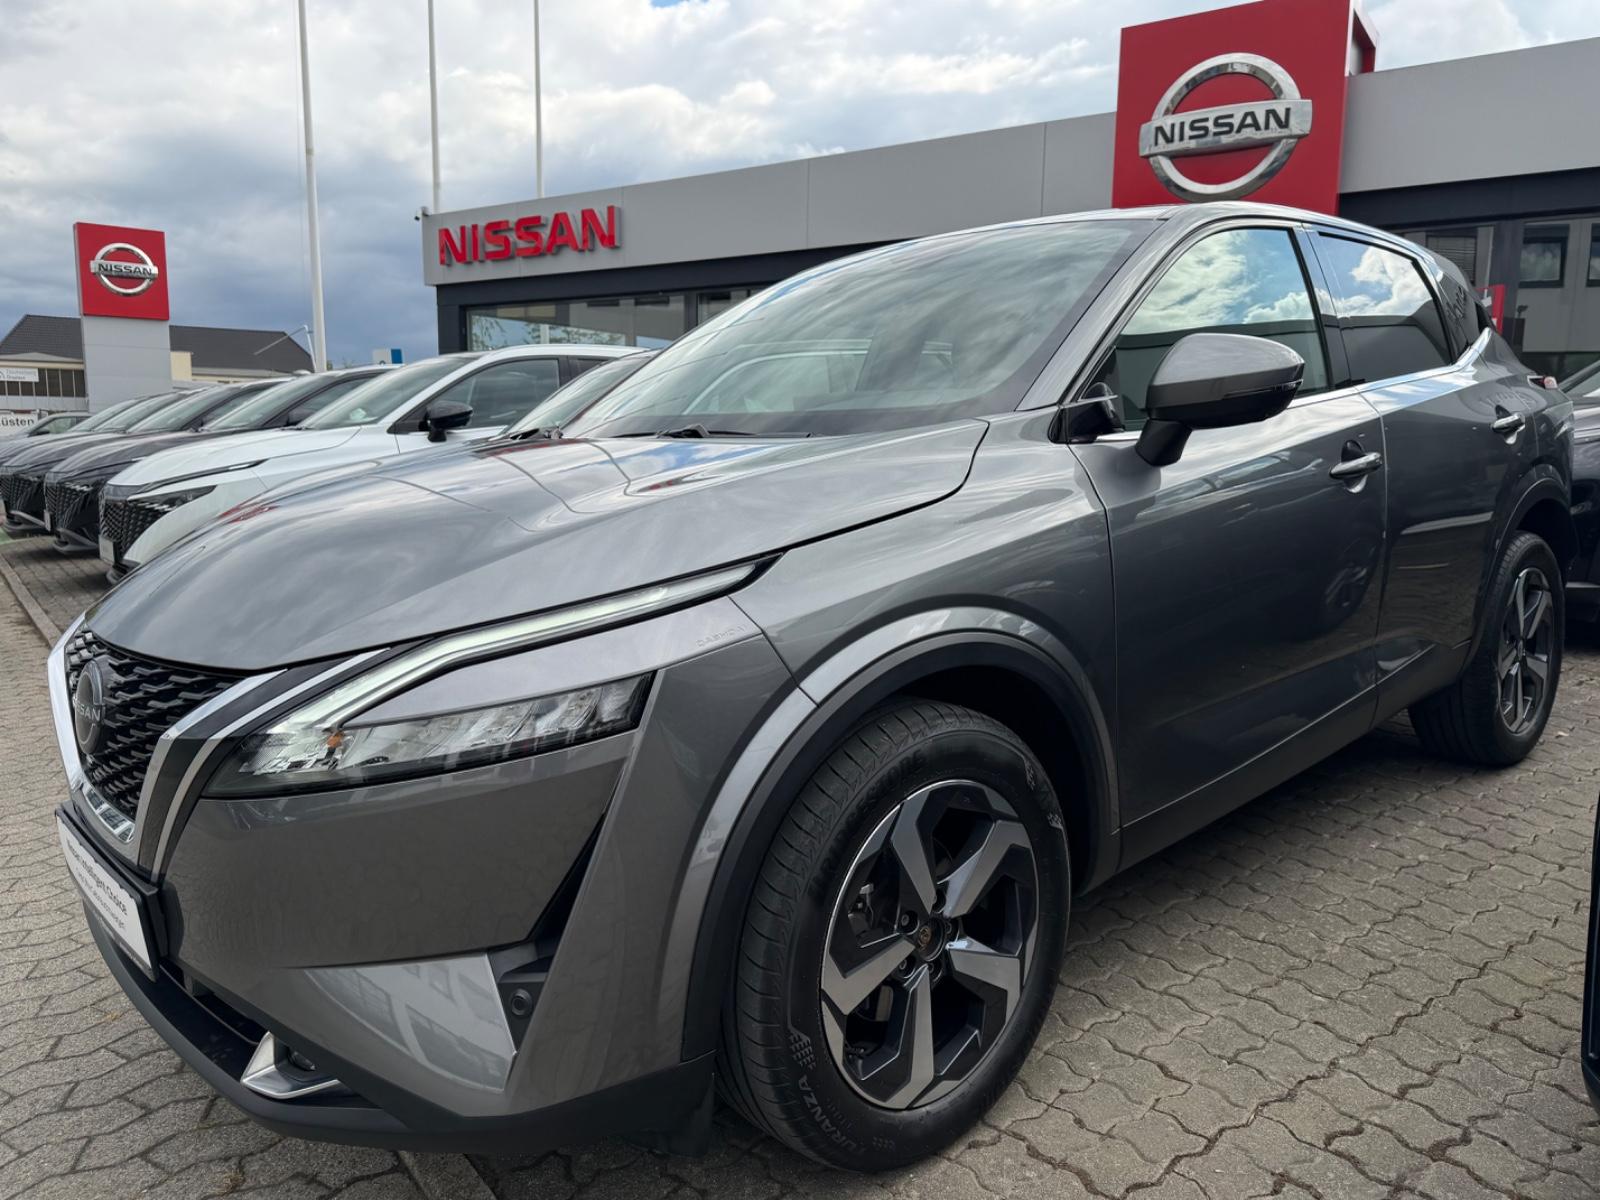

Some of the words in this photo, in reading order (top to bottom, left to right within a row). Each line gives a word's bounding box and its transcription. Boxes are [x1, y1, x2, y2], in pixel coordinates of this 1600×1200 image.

[1154, 107, 1292, 146] NISSAN
[438, 204, 618, 266] NISSAN
[98, 263, 152, 276] NISSAN
[0, 415, 34, 427] üsten
